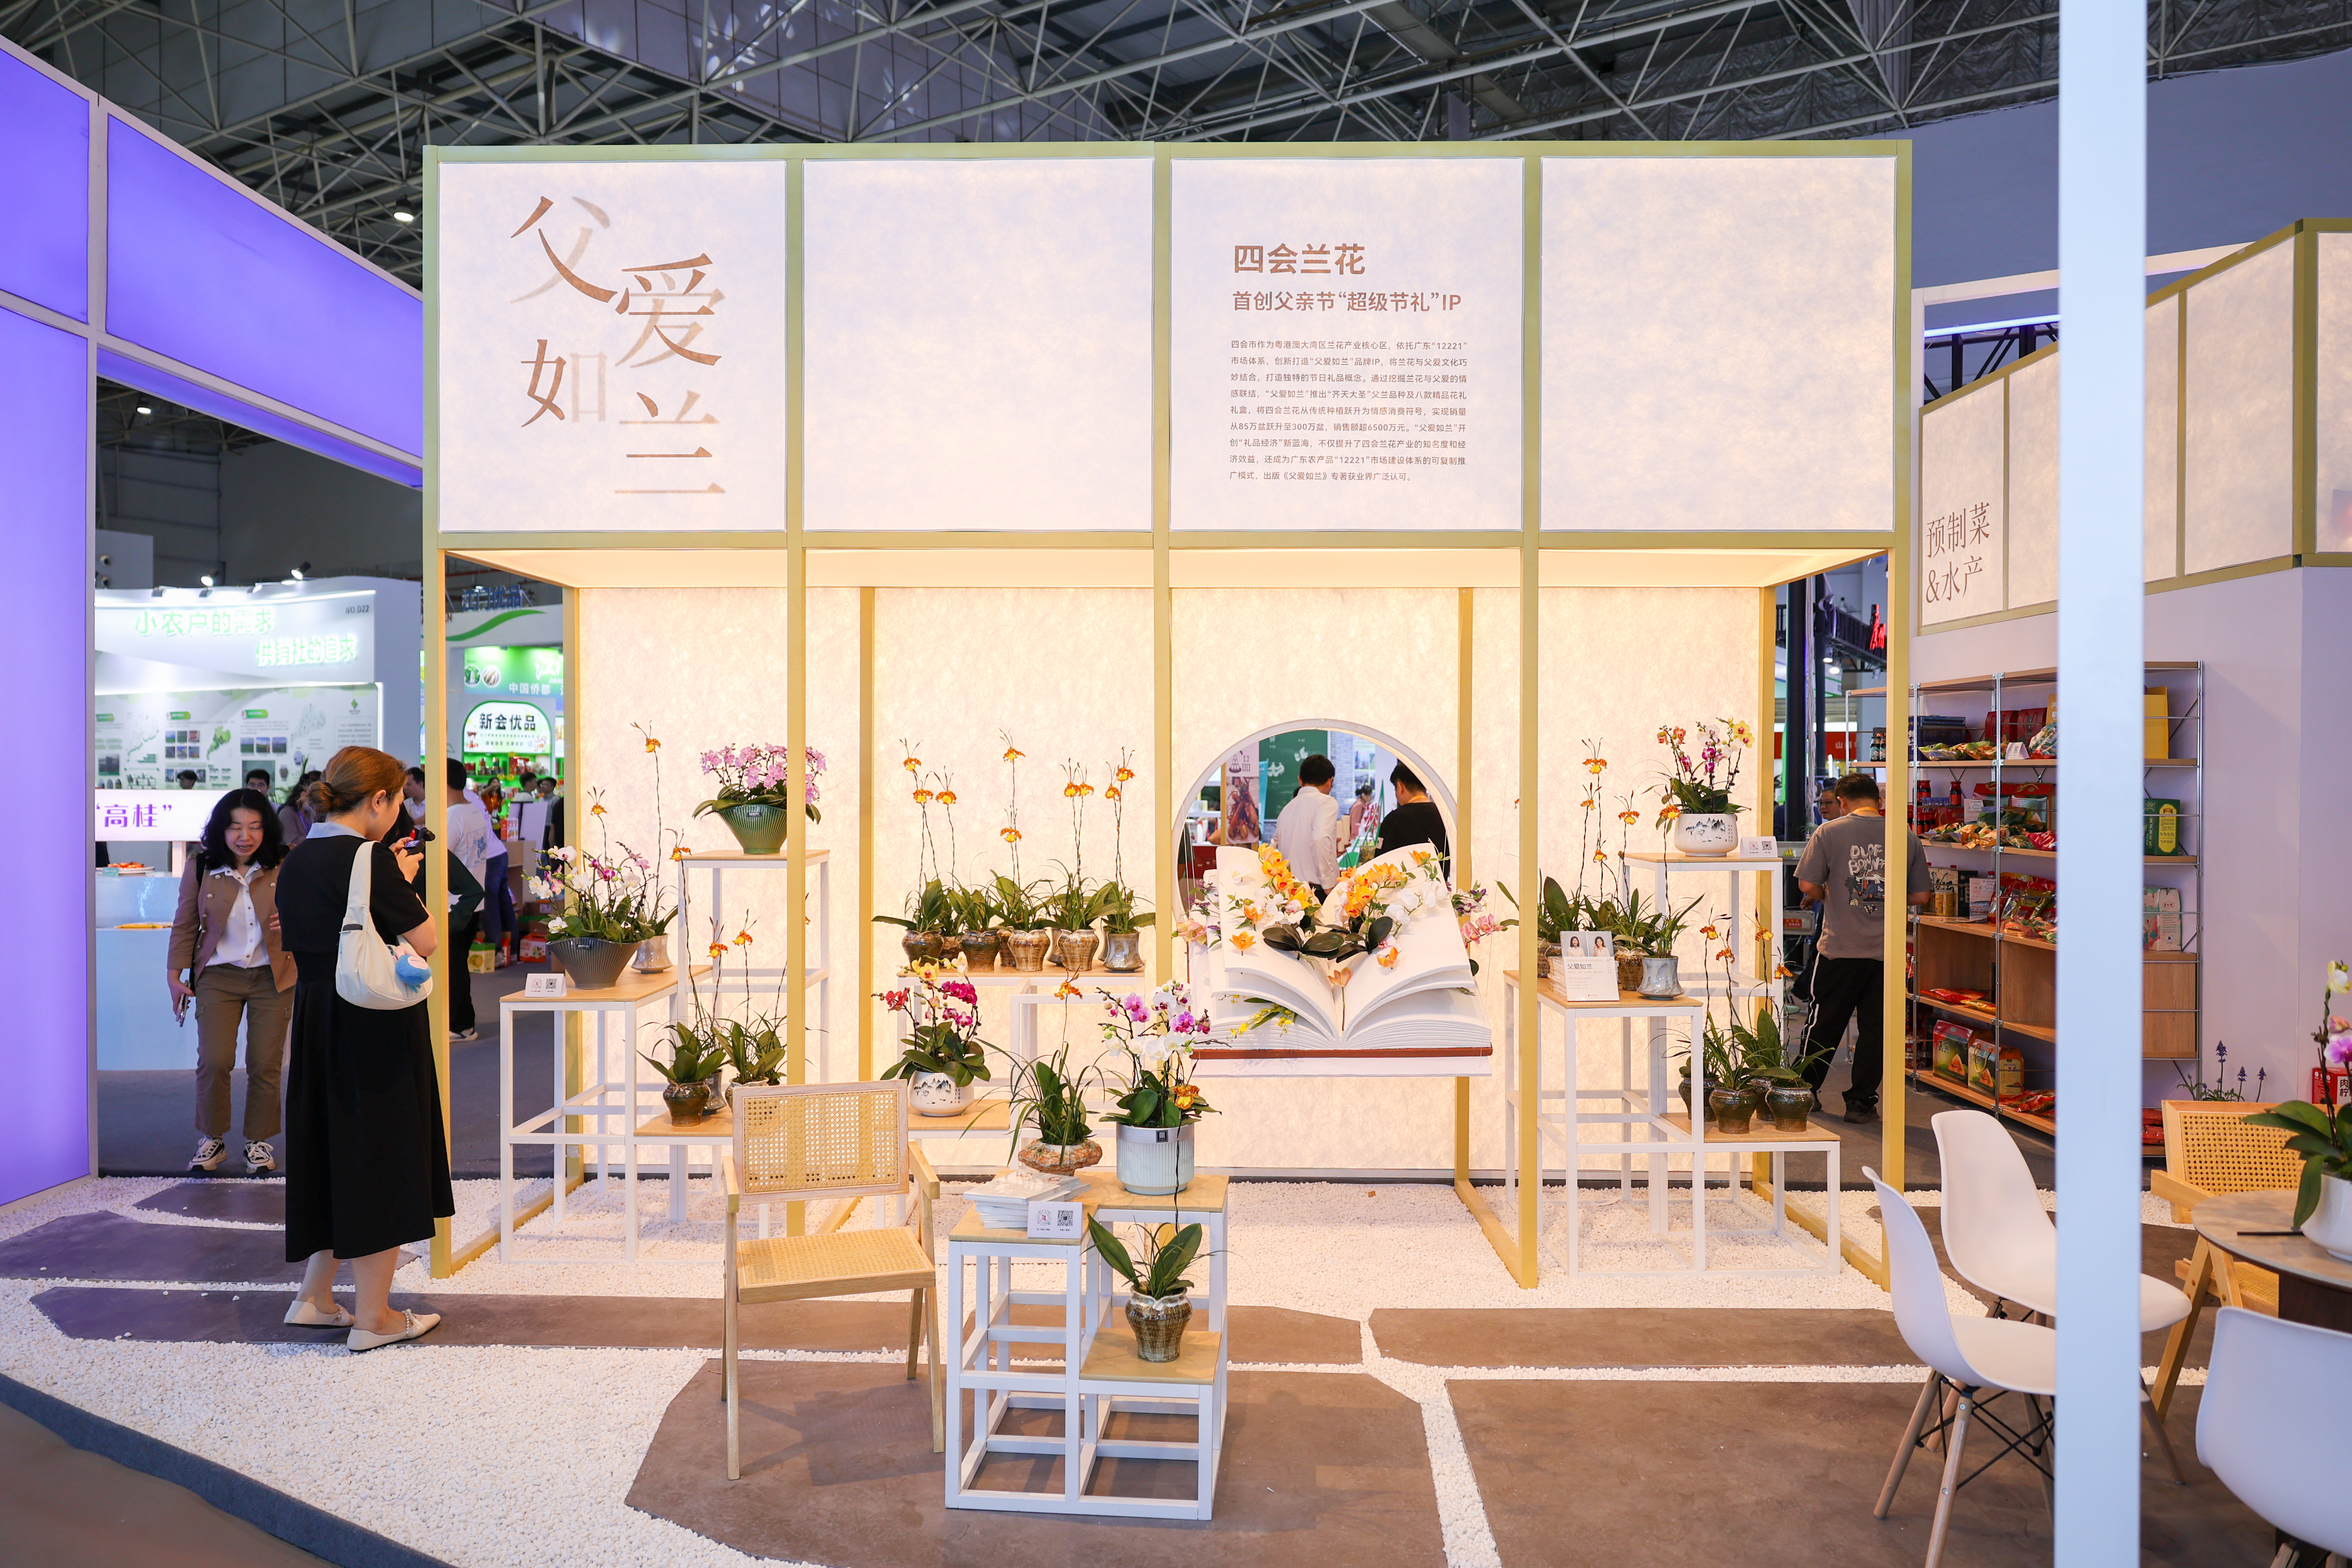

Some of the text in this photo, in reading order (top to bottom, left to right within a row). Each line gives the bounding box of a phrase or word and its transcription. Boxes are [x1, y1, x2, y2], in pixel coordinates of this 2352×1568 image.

[1234, 243, 1365, 275] 四会兰花
[1233, 291, 1461, 312] 首创父亲节“超级节礼”IP
[1926, 502, 1990, 558] 预制菜
[1926, 555, 1983, 603] &水产
[345, 604, 369, 614] NO.D22
[462, 585, 521, 612] 江门优品
[134, 608, 274, 635] 小农户的需求
[256, 633, 357, 667] 供销社的追求
[509, 682, 550, 695] 中国侨都
[479, 713, 536, 731] 新会优品
